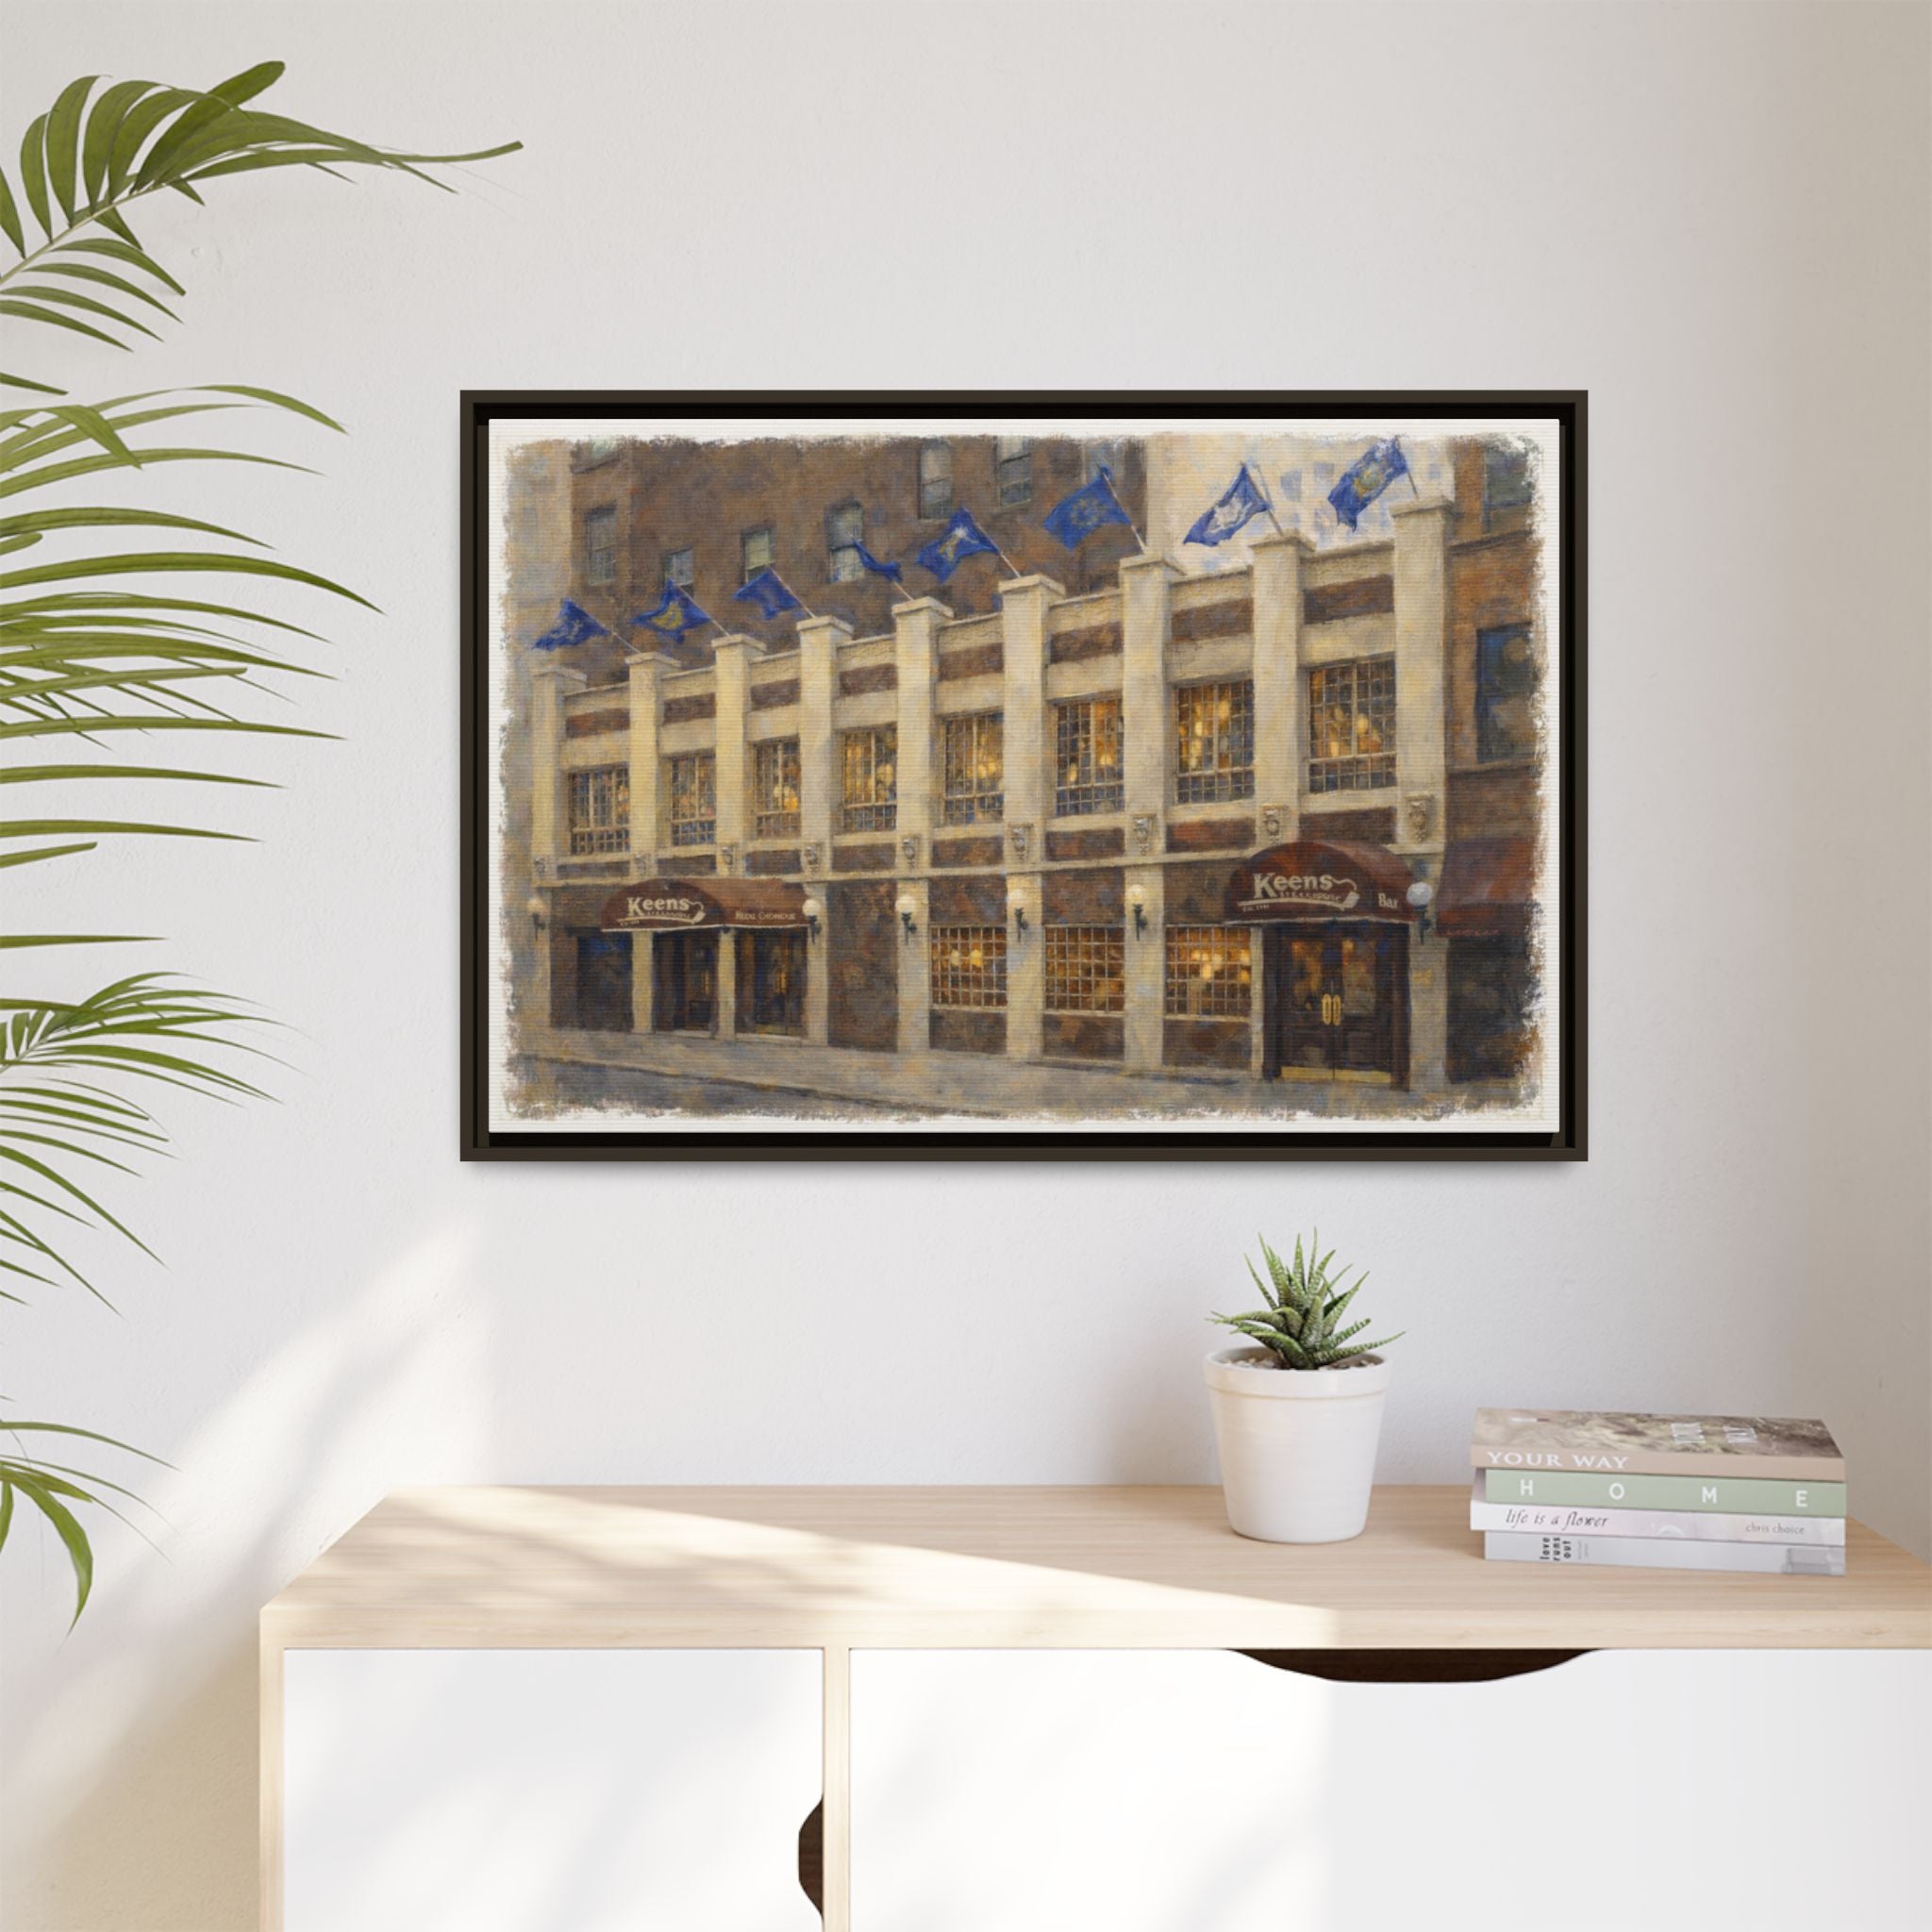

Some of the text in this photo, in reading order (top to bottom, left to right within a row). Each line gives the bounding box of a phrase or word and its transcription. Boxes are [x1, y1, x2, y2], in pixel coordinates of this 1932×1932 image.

[1252, 872, 1333, 898] Keens
[626, 897, 690, 917] Keens
[1378, 892, 1398, 909] Bar
[1487, 1451, 1628, 1469] YOUR WAY
[1506, 1508, 1608, 1530] life is a flower
[1540, 1537, 1550, 1560] love
[1562, 1541, 1572, 1558] out
